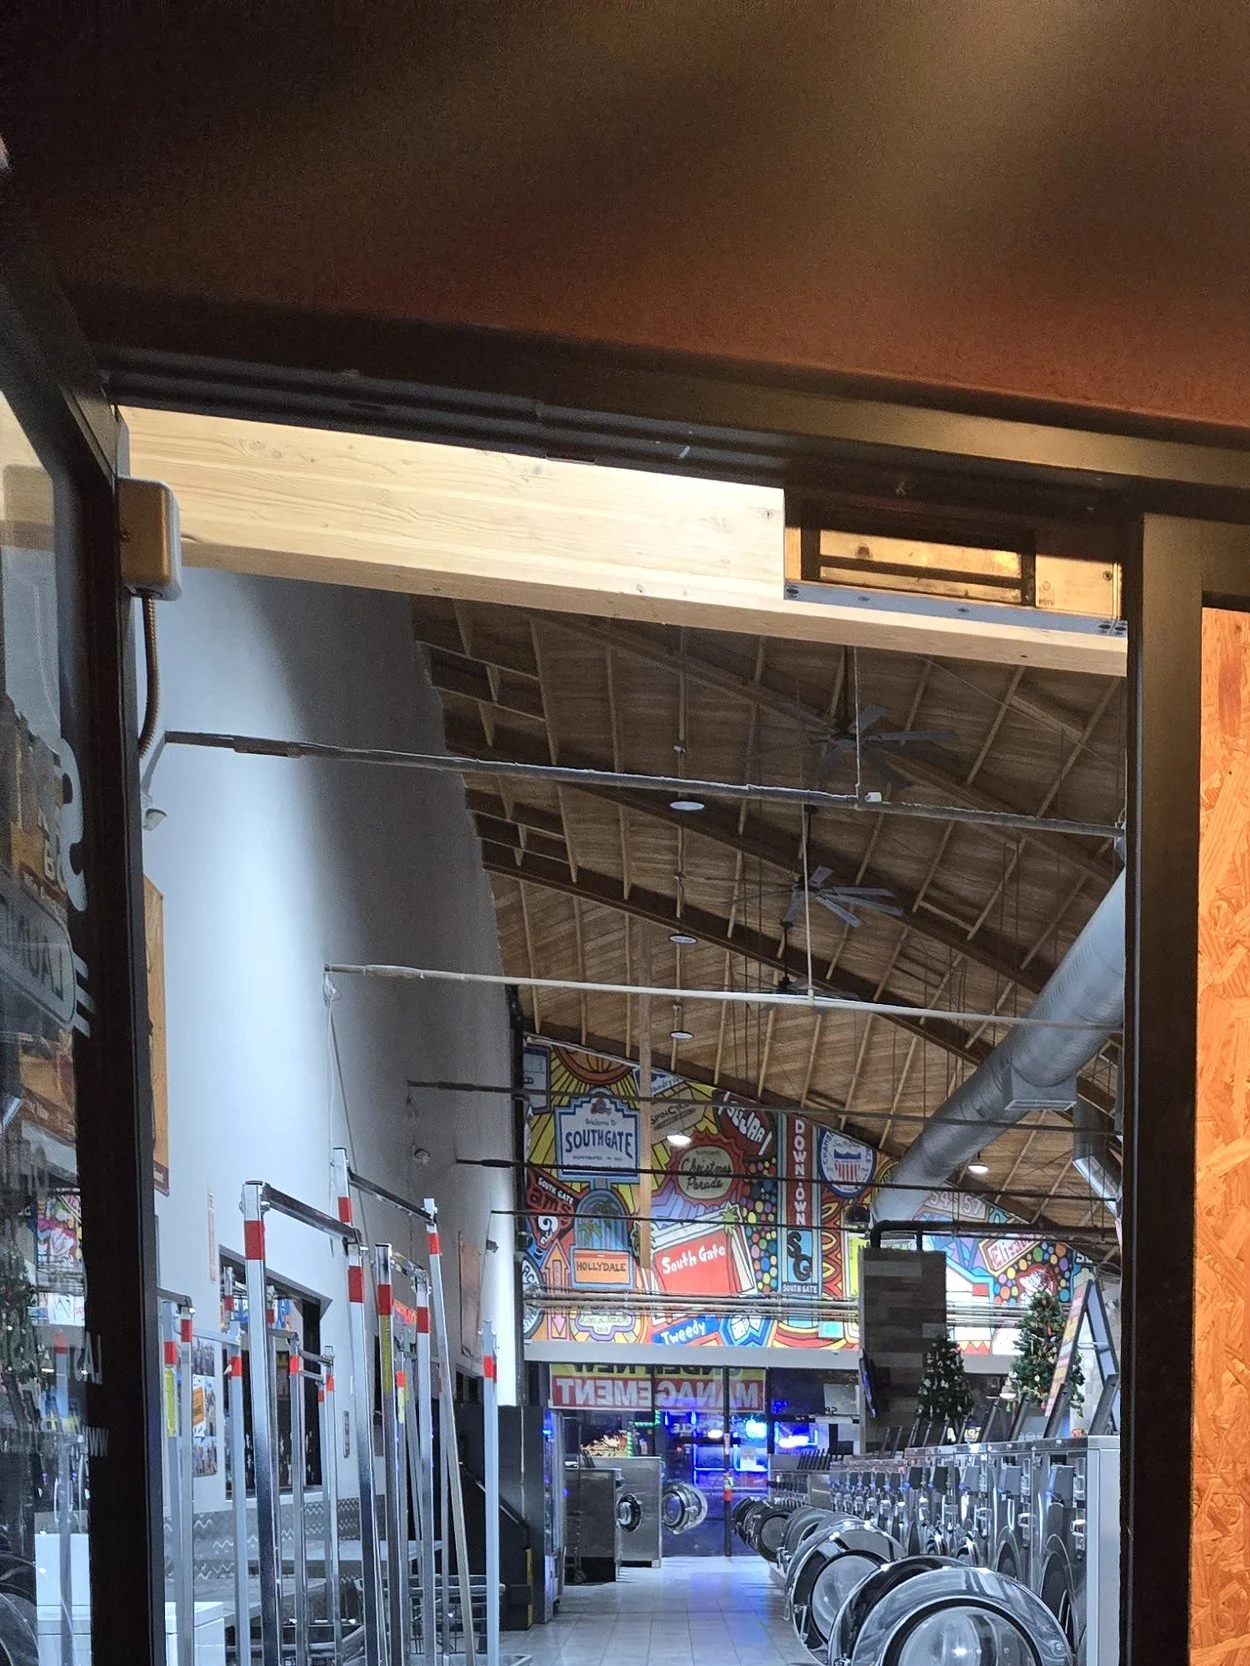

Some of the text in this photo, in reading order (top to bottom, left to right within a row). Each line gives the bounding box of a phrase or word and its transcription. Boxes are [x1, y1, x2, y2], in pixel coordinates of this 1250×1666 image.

[565, 1129, 633, 1160] SOUTHGATE
[538, 1177, 574, 1205] SOUTH GATE
[686, 1176, 723, 1191] Parade
[576, 1261, 627, 1273] HOLLYDALE
[661, 1243, 726, 1275] South Gate
[782, 1283, 818, 1294] SOUTH GATE
[661, 1319, 706, 1346] Tweedy
